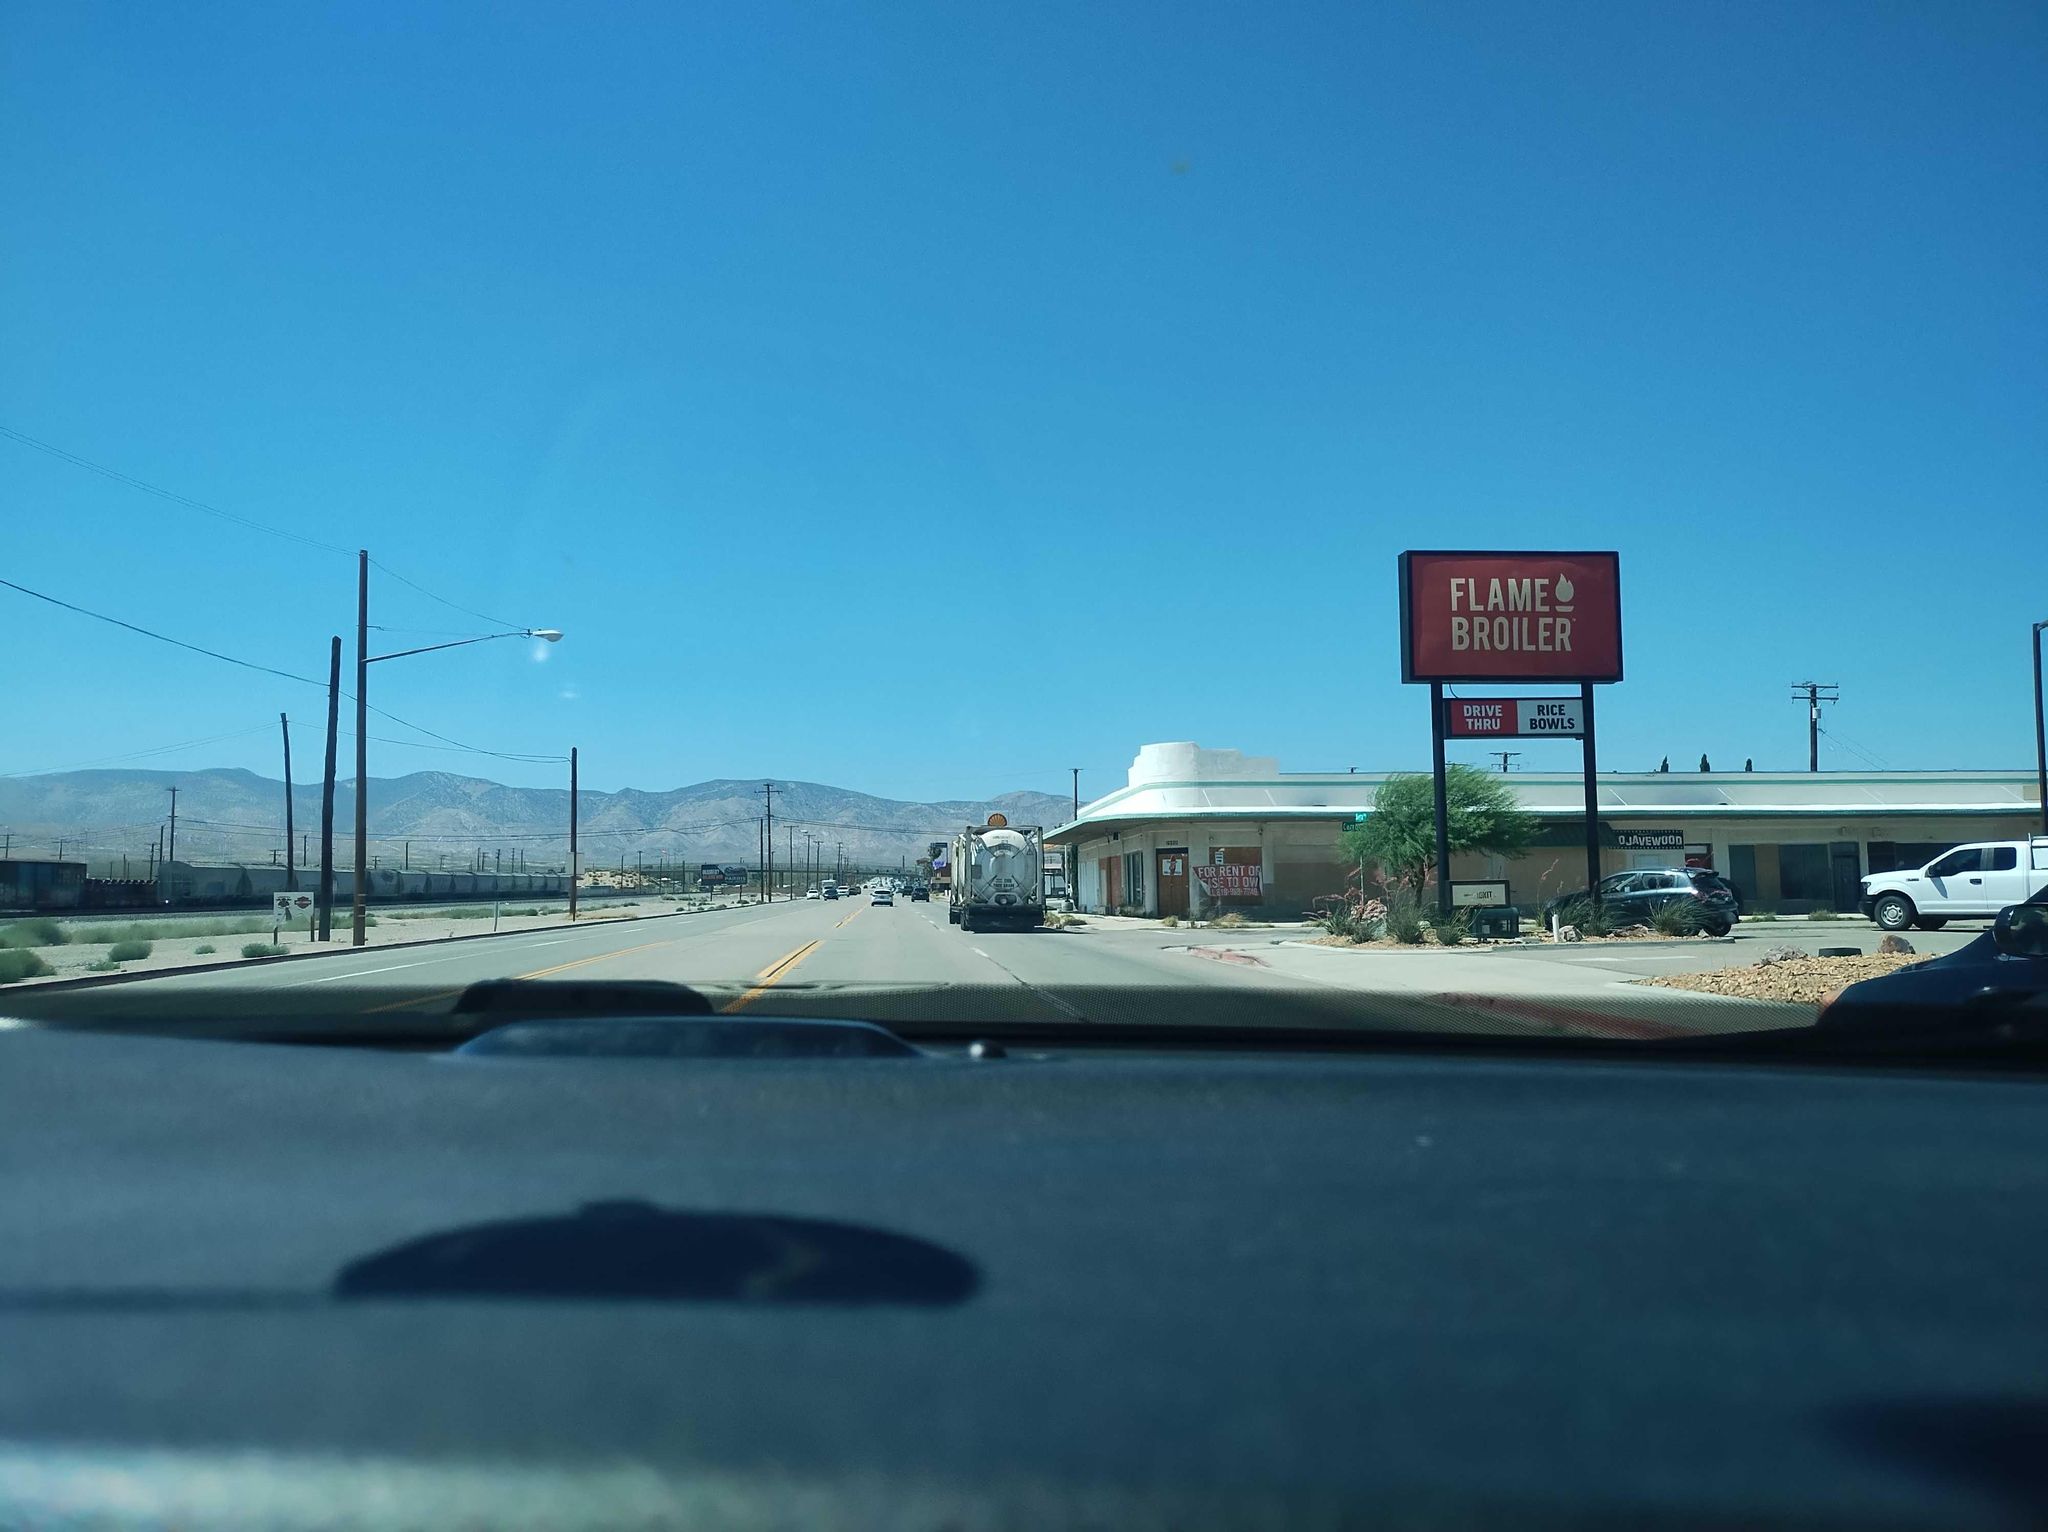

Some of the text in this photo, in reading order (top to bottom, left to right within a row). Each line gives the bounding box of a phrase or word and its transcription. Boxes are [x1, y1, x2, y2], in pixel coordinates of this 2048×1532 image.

[1451, 578, 1549, 612] FLAME
[1452, 617, 1572, 651] BROILER
[1463, 704, 1503, 717] DRIVE
[1536, 704, 1566, 717] RICE
[1466, 718, 1500, 730] THRU
[1529, 717, 1575, 730] BOWLS
[1618, 835, 1682, 846] OJAVEWOOD
[1197, 867, 1216, 878] FOR
[1219, 866, 1246, 877] RENT
[1226, 877, 1239, 888] TO
